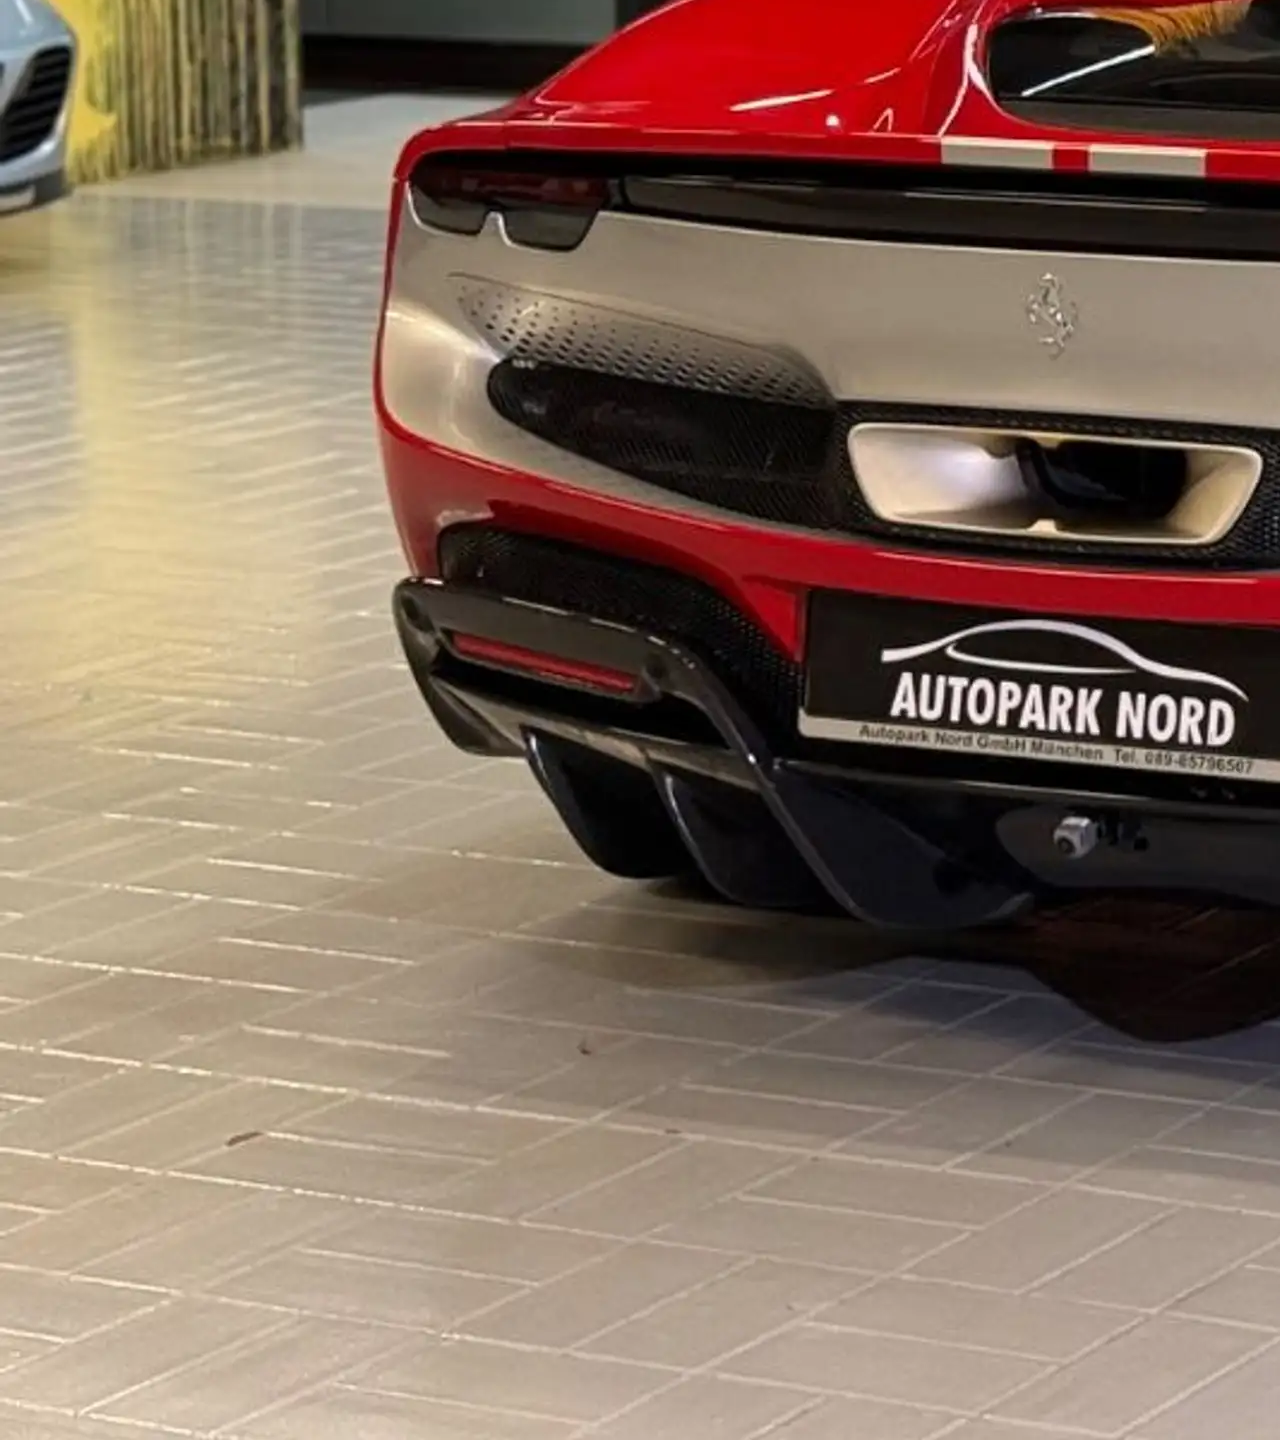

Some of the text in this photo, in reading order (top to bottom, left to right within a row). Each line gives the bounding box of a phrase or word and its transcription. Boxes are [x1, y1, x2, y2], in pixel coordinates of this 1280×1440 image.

[890, 671, 1236, 747] AUTOPARK NORD
[859, 724, 931, 743] Autopark
[934, 731, 973, 748] Nord
[976, 734, 1026, 752] GmbH
[1030, 739, 1104, 760] München
[1113, 748, 1138, 764] Tel.
